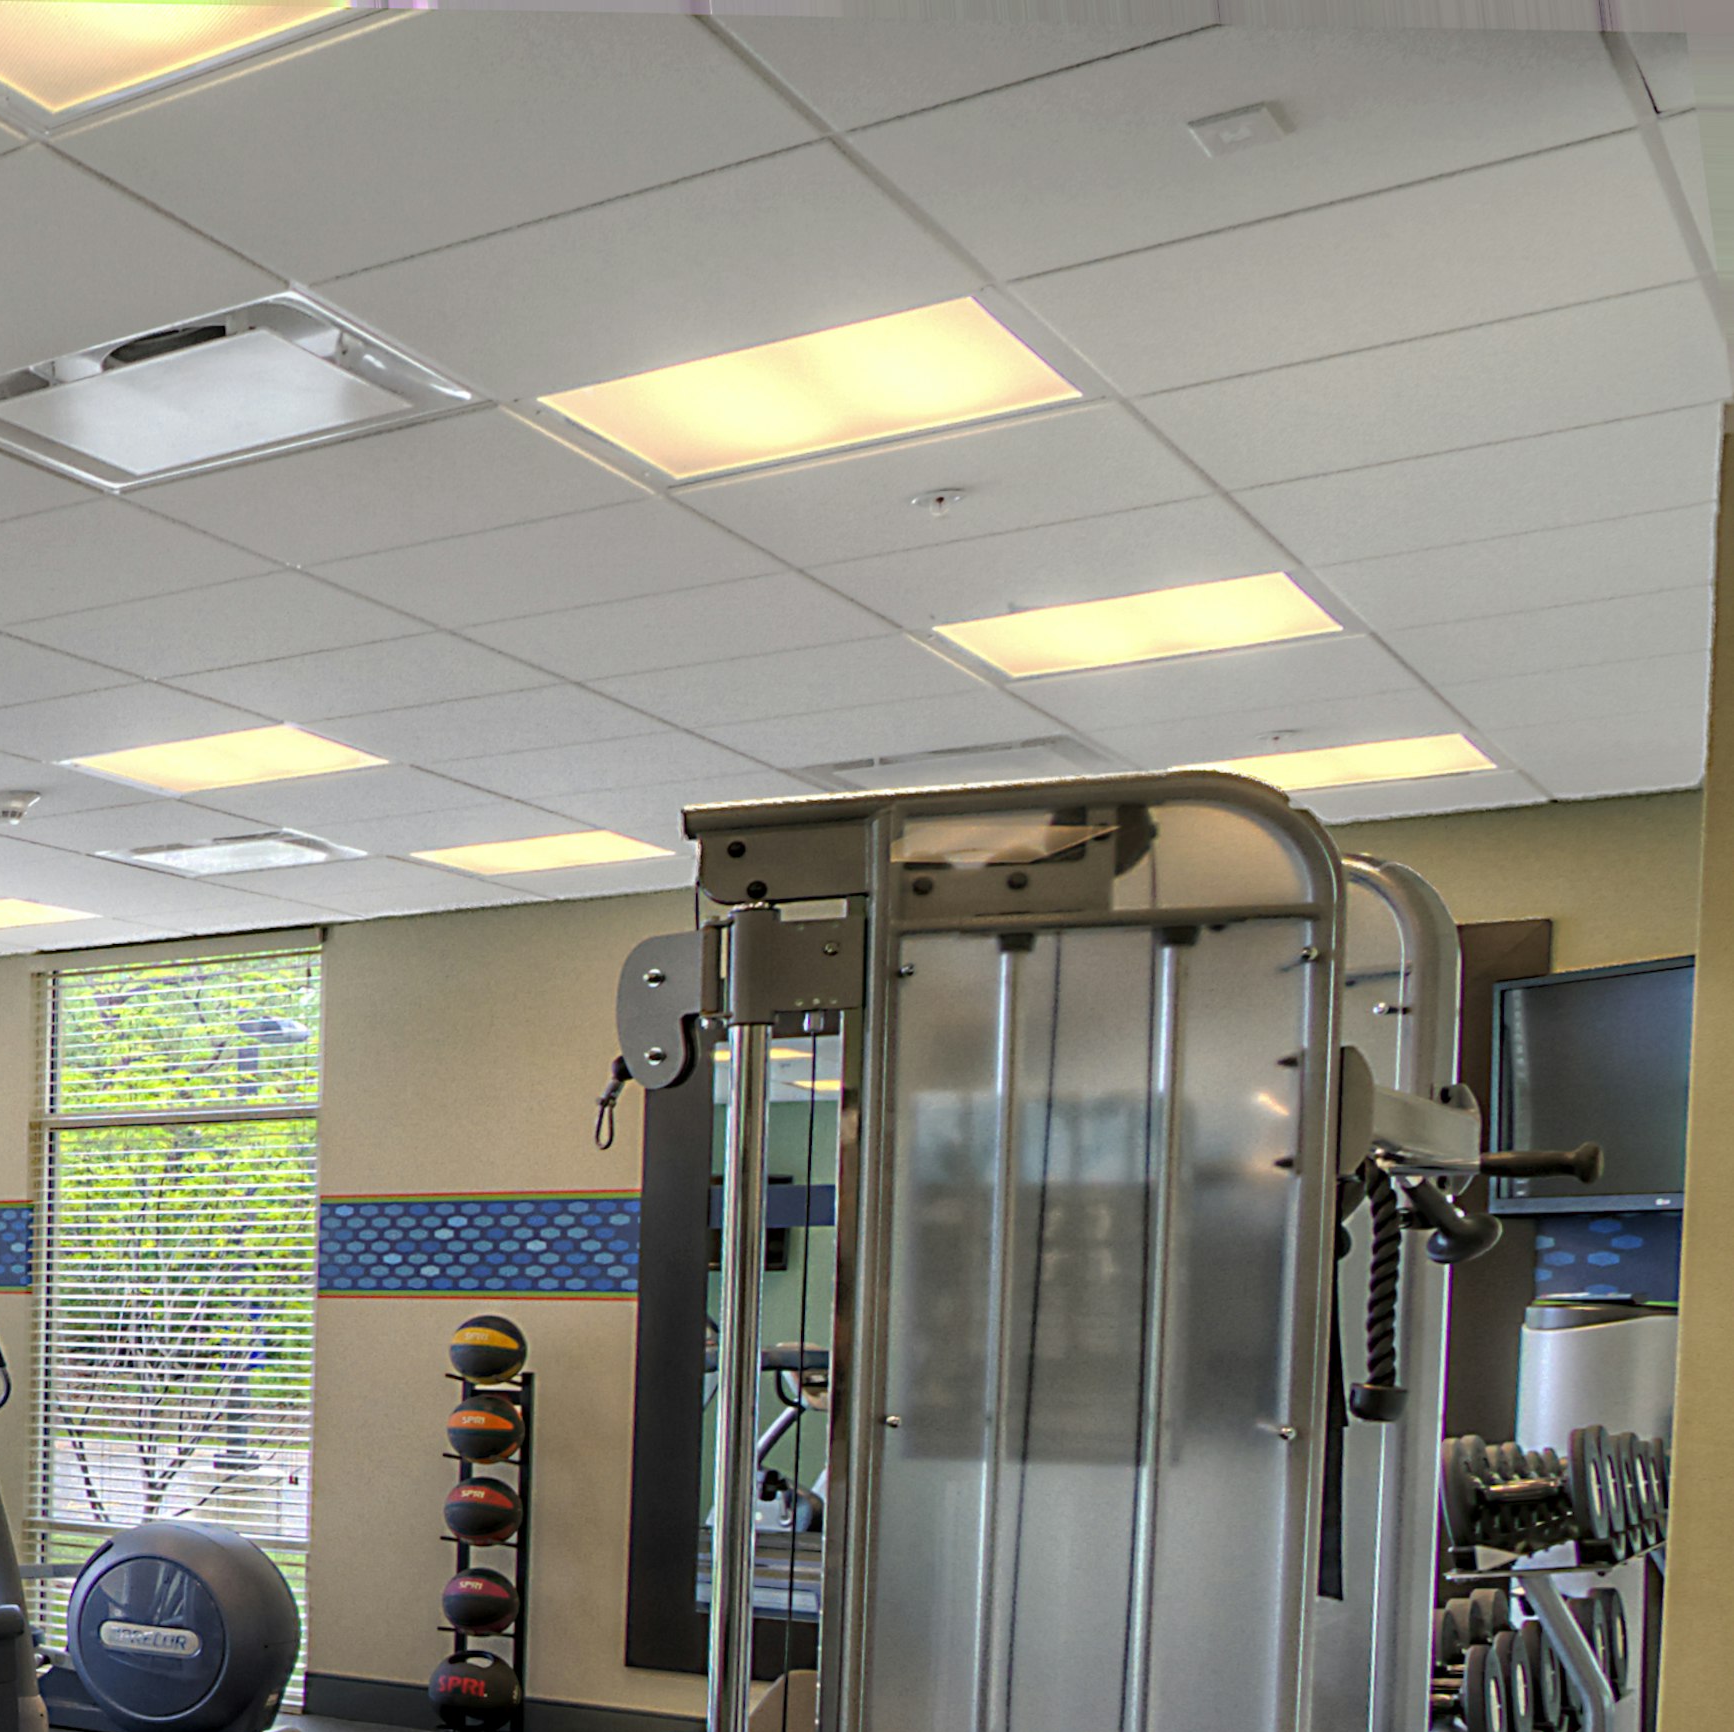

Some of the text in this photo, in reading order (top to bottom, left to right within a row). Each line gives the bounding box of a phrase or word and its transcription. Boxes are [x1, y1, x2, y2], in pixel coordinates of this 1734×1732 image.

[462, 1416, 486, 1424] SPRI
[461, 1489, 485, 1498] SPRI
[459, 1581, 483, 1591] SPRI
[437, 1675, 485, 1697] SPRI
